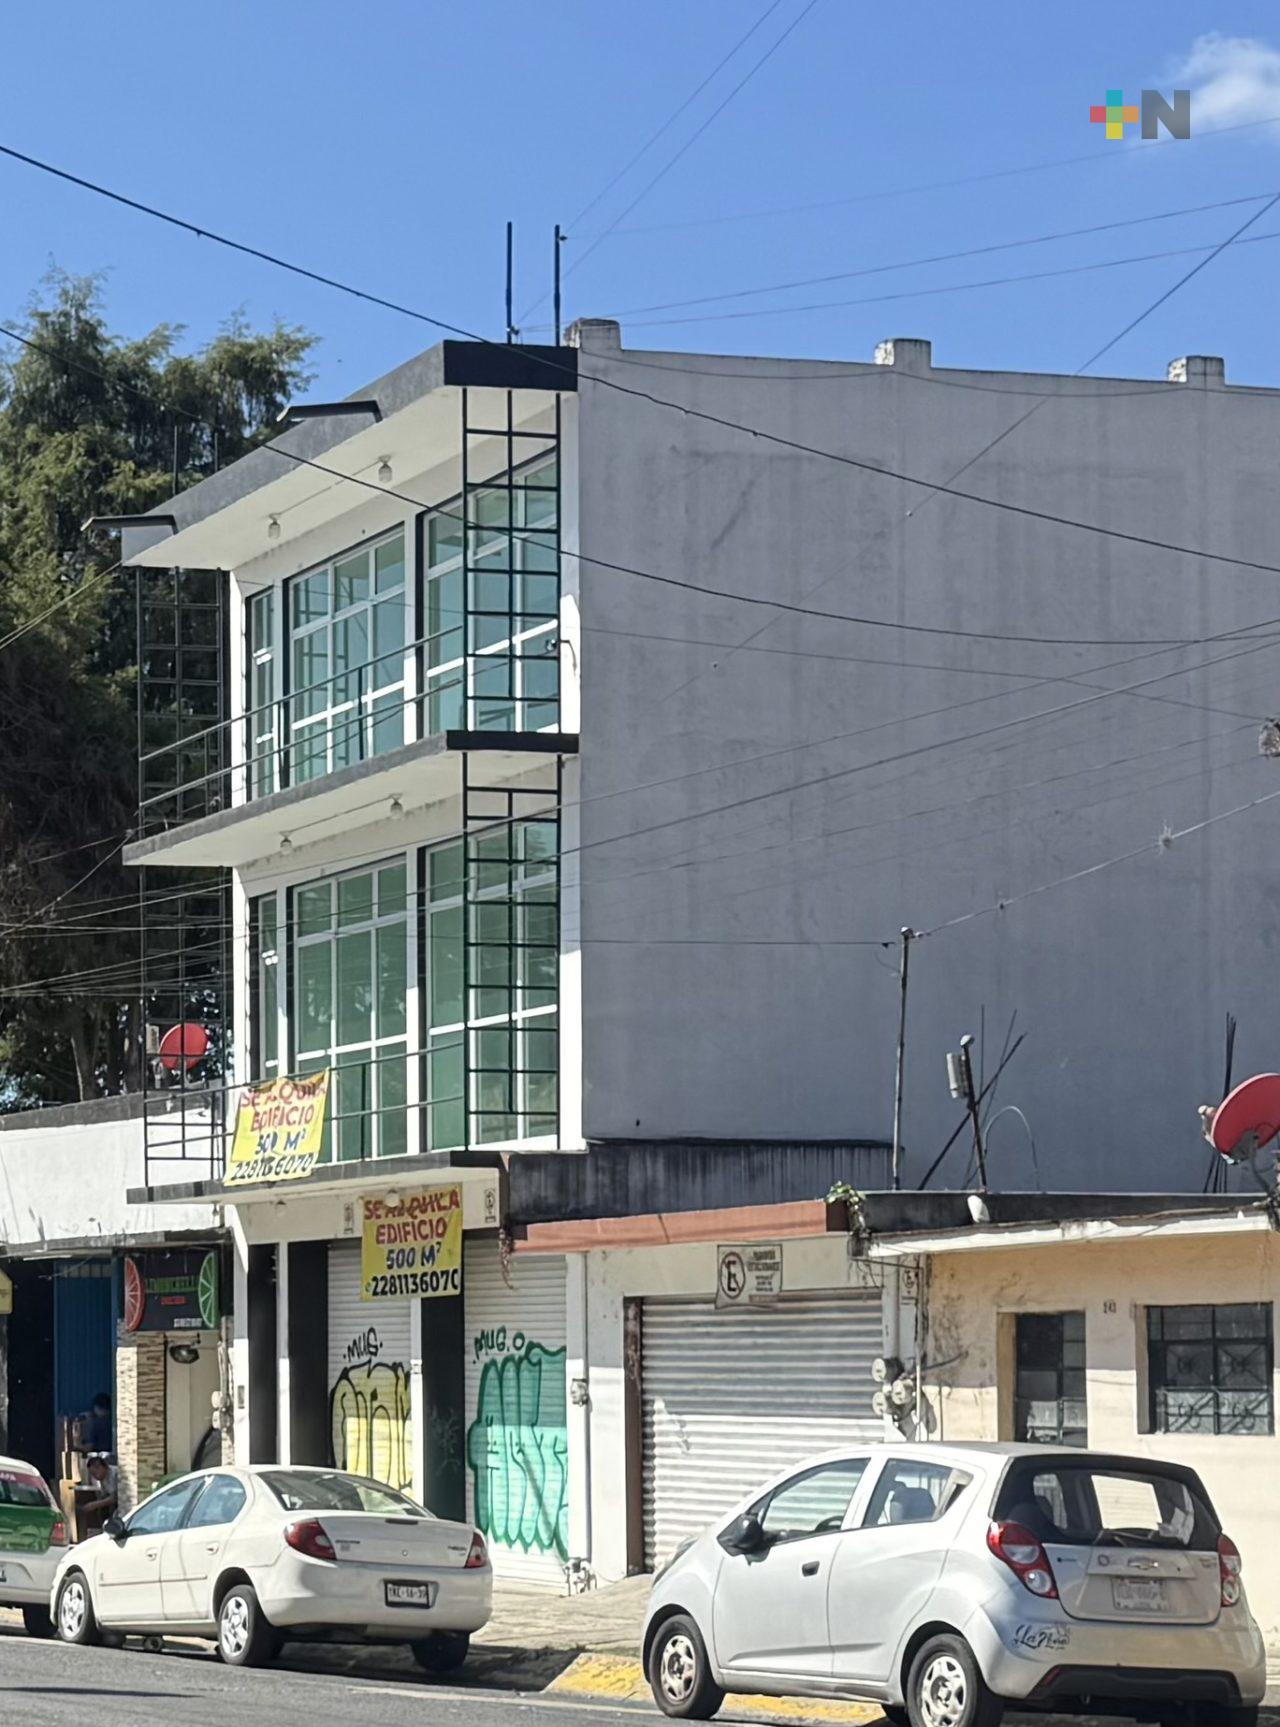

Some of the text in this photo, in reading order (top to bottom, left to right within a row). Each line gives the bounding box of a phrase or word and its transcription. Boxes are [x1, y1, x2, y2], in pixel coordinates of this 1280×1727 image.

[251, 1104, 314, 1132] EDIFICIO
[364, 1200, 382, 1220] SE
[376, 1217, 448, 1245] EDIFICIO
[387, 1247, 416, 1270] 500
